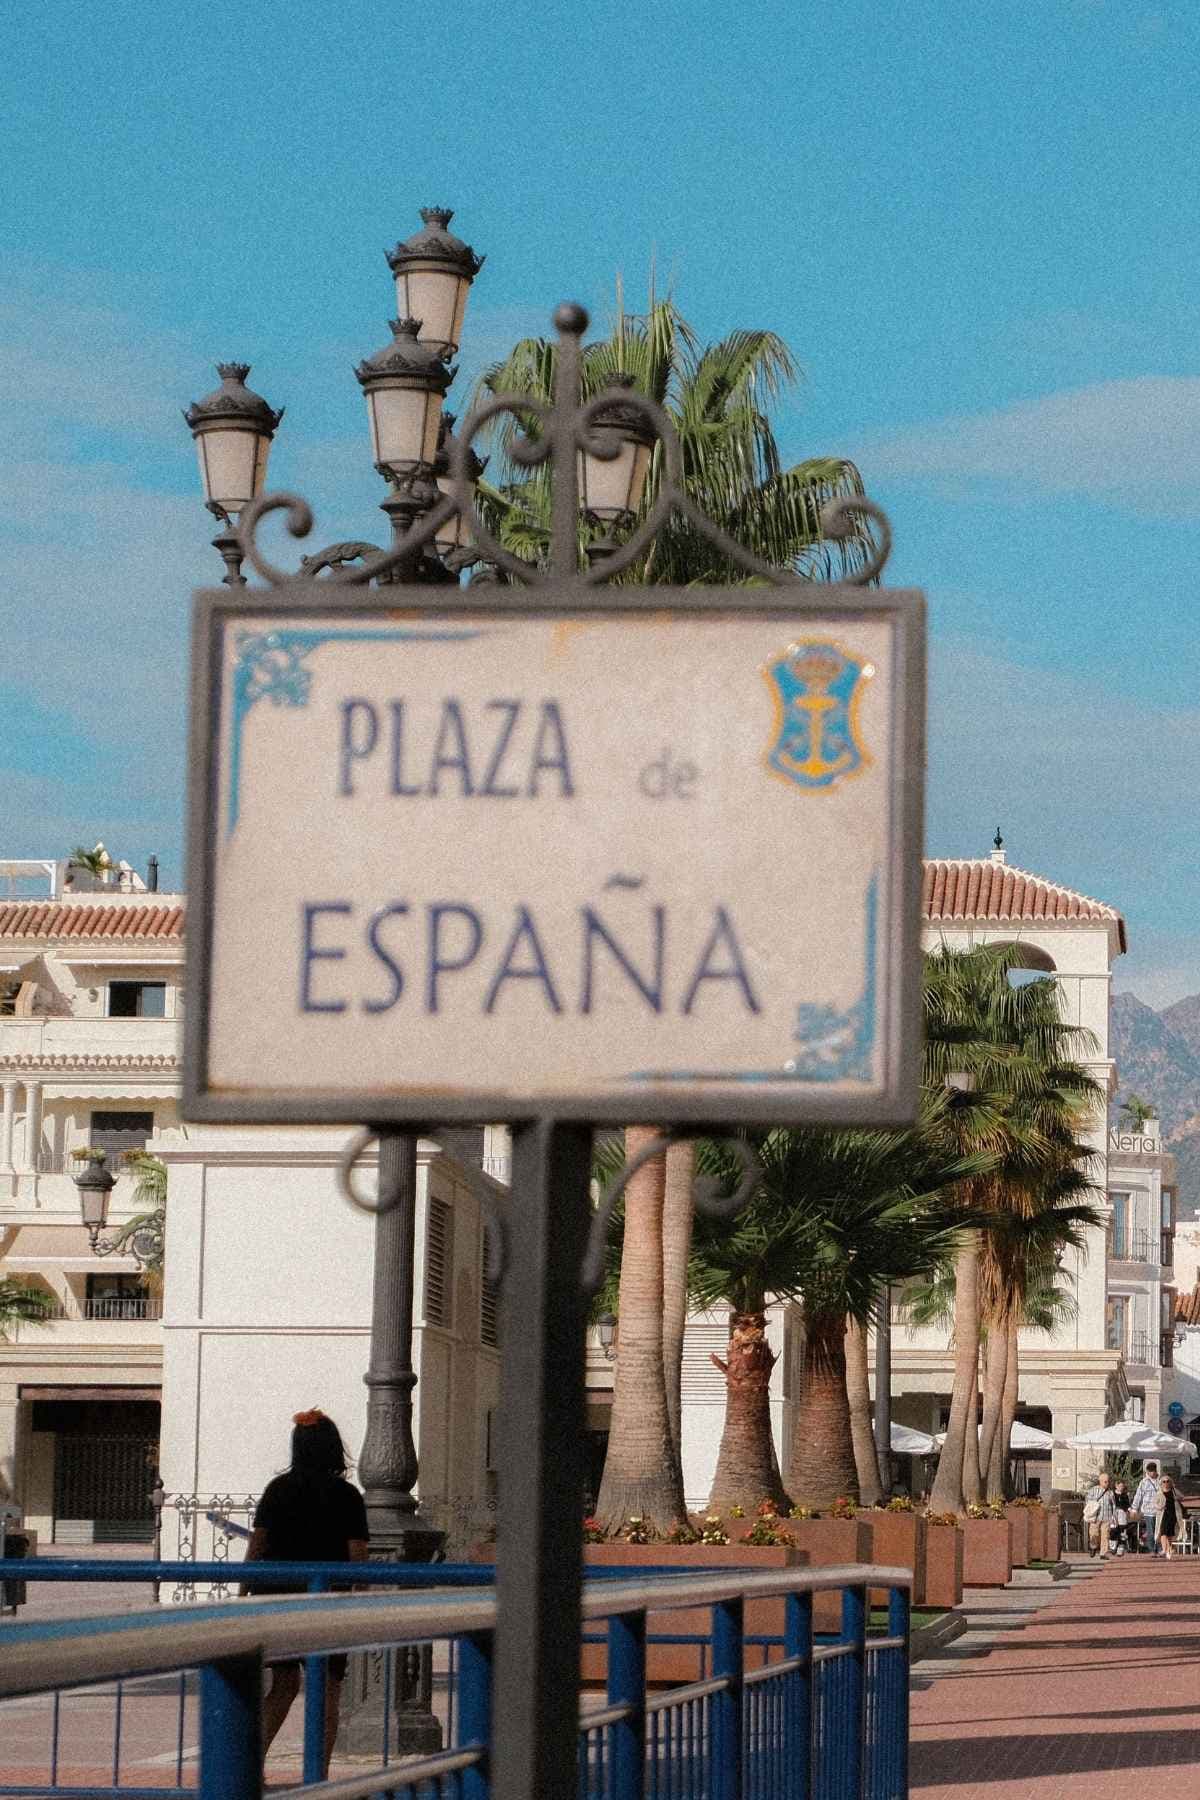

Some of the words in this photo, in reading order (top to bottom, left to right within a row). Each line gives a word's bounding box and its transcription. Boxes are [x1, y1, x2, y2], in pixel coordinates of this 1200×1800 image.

[338, 696, 576, 799] PLAZA
[638, 749, 699, 801] de
[298, 873, 762, 1017] ESPAÑA
